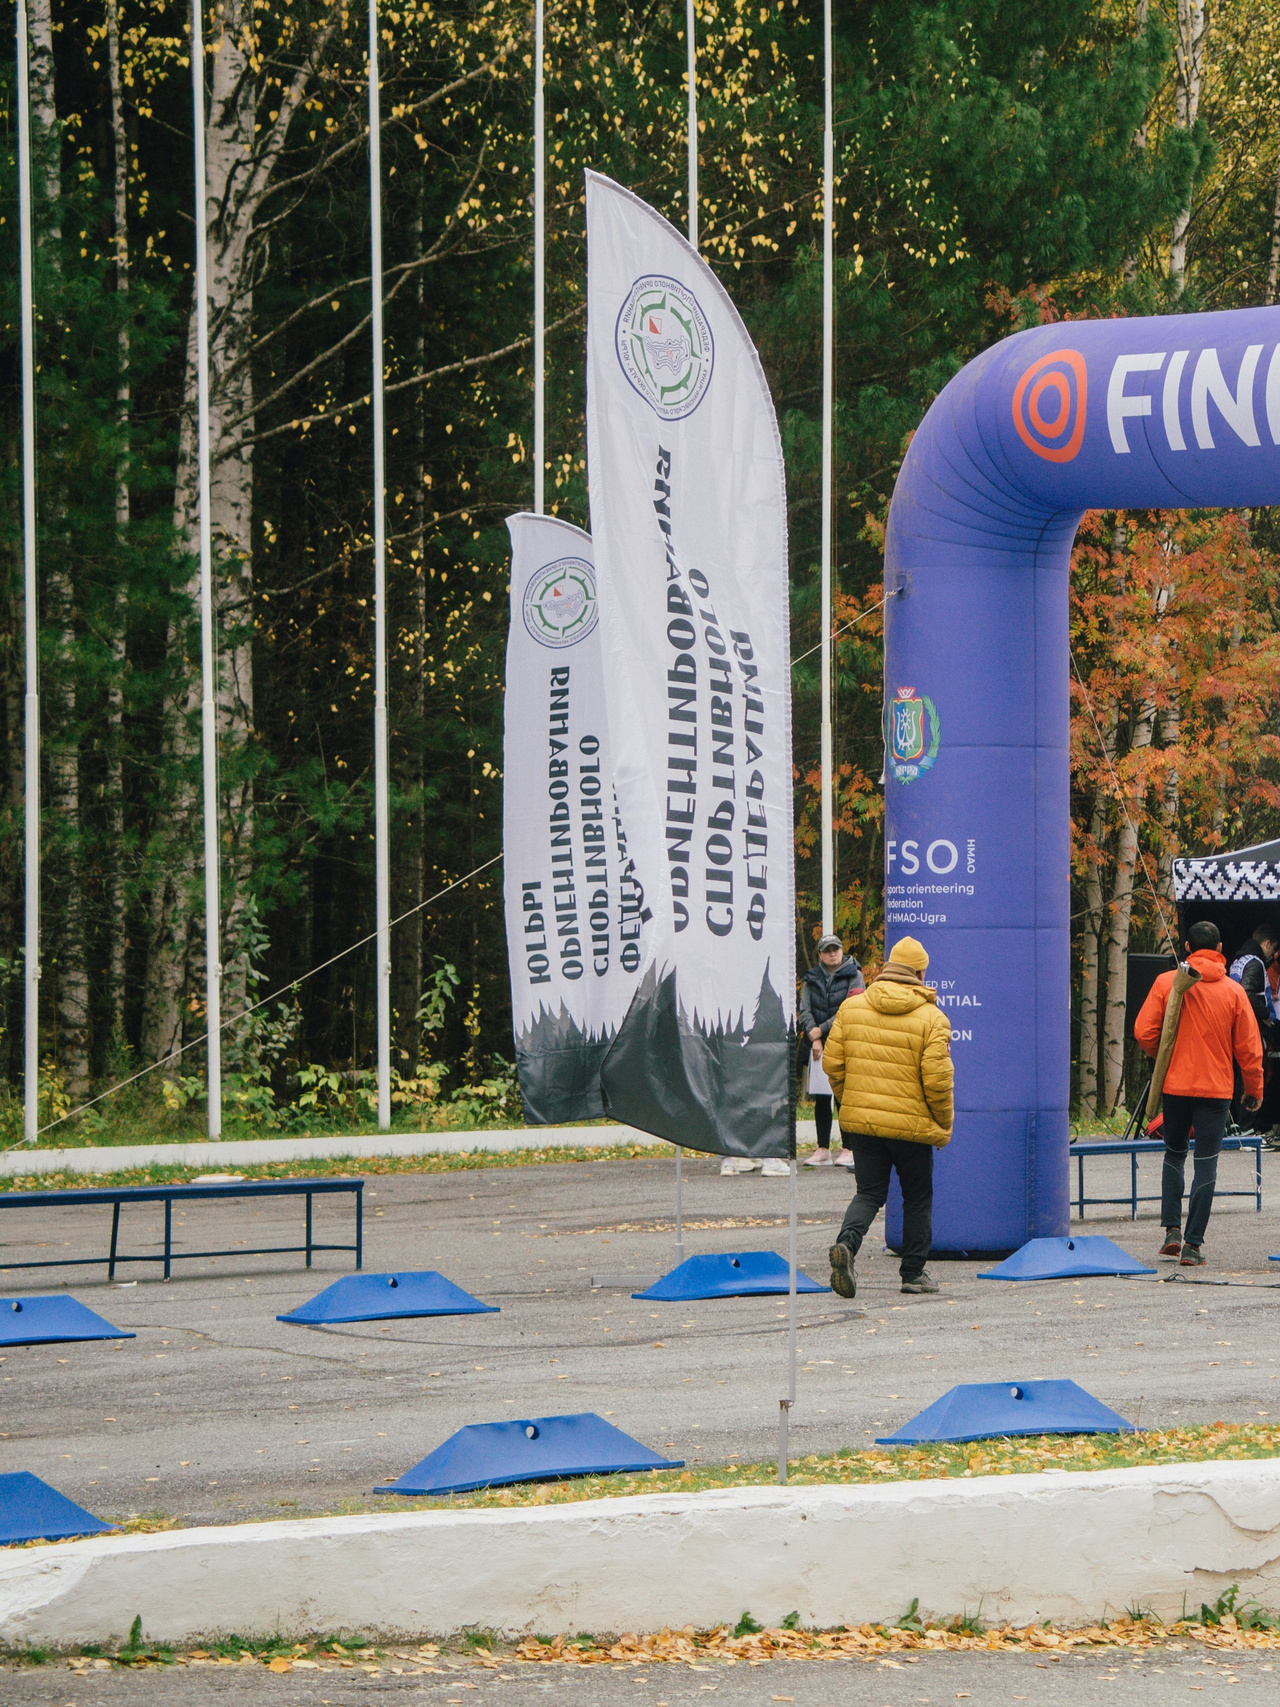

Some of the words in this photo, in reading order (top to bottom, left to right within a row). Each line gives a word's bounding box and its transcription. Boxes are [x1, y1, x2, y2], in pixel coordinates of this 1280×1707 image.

[887, 839, 959, 875] FSO
[966, 838, 976, 874] HMAO
[887, 884, 906, 895] sports
[906, 883, 975, 896] orienteering
[892, 912, 947, 925] HMAO-Ugra
[941, 980, 956, 989] BY
